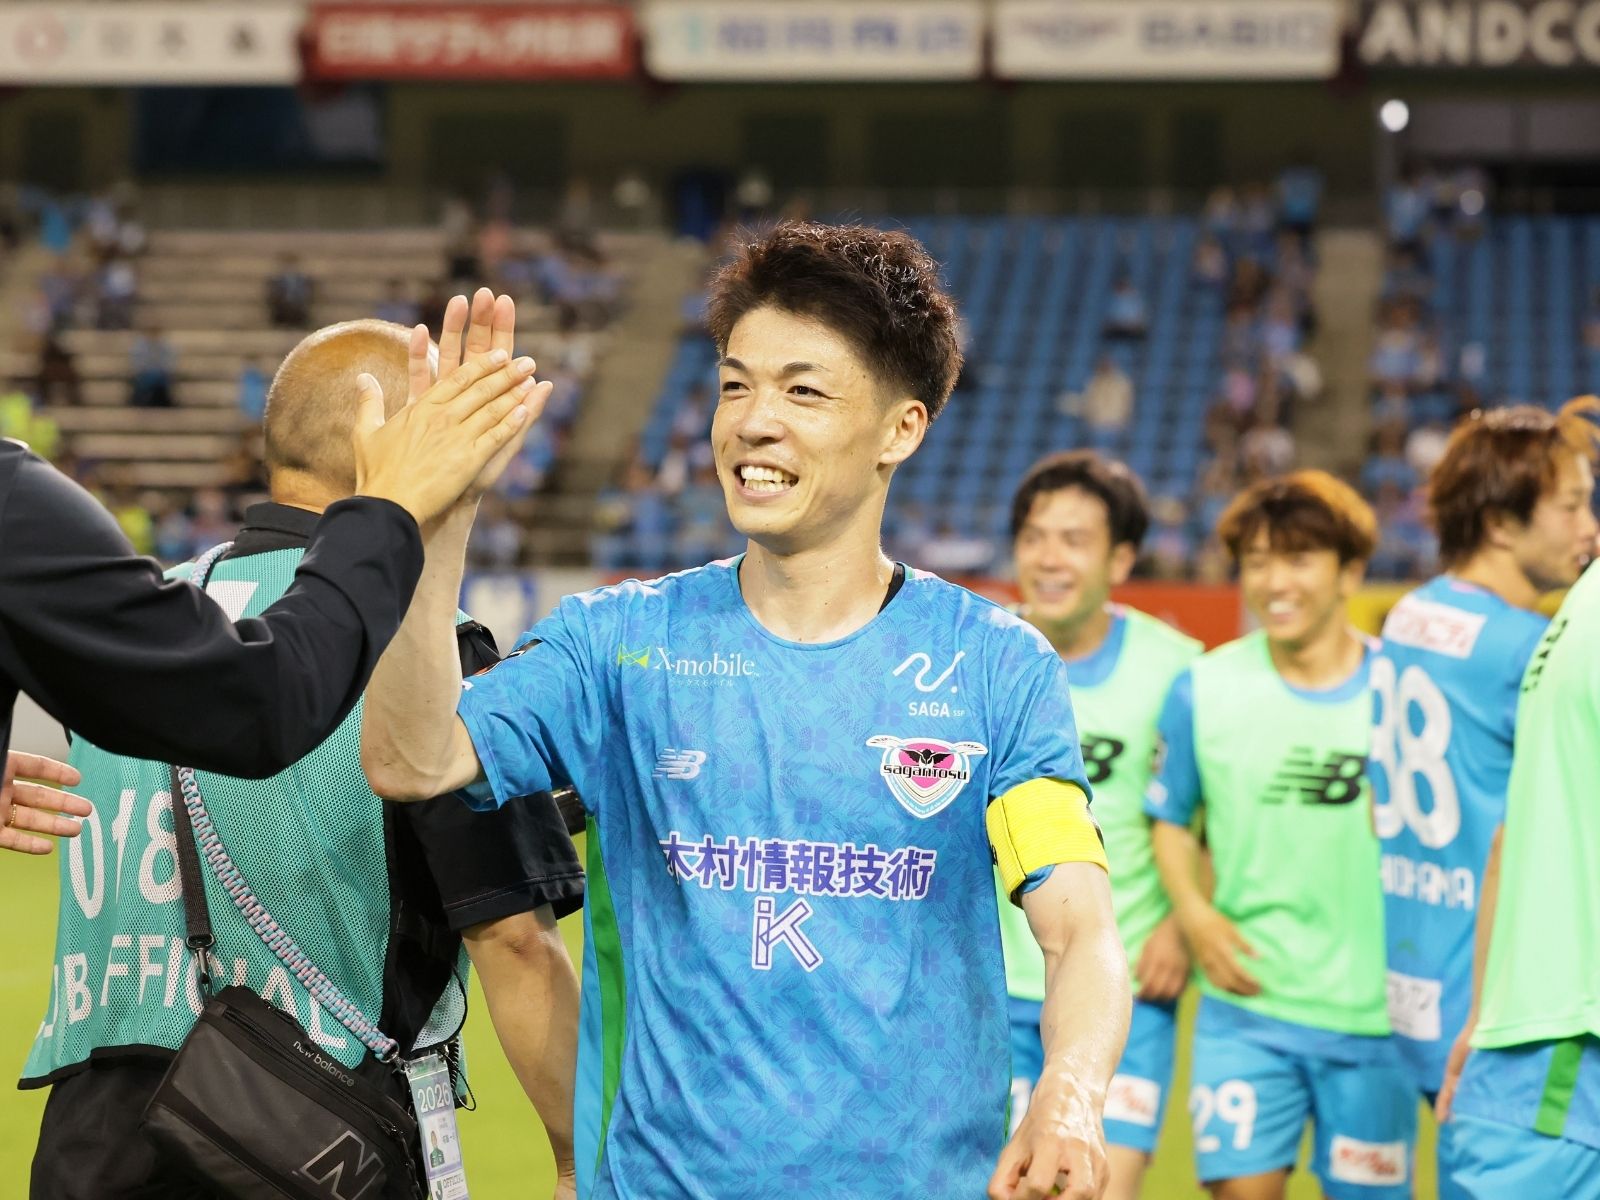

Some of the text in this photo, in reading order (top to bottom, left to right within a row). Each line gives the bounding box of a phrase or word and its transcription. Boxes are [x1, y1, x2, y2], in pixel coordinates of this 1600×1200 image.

[654, 647, 755, 677] X-mobile
[908, 702, 951, 718] SAGA
[883, 764, 967, 781] sagantosu
[659, 831, 937, 900] 木村情報技術
[293, 1038, 355, 1088] new balance
[417, 1081, 451, 1113] 2026
[1189, 1079, 1258, 1152] 29
